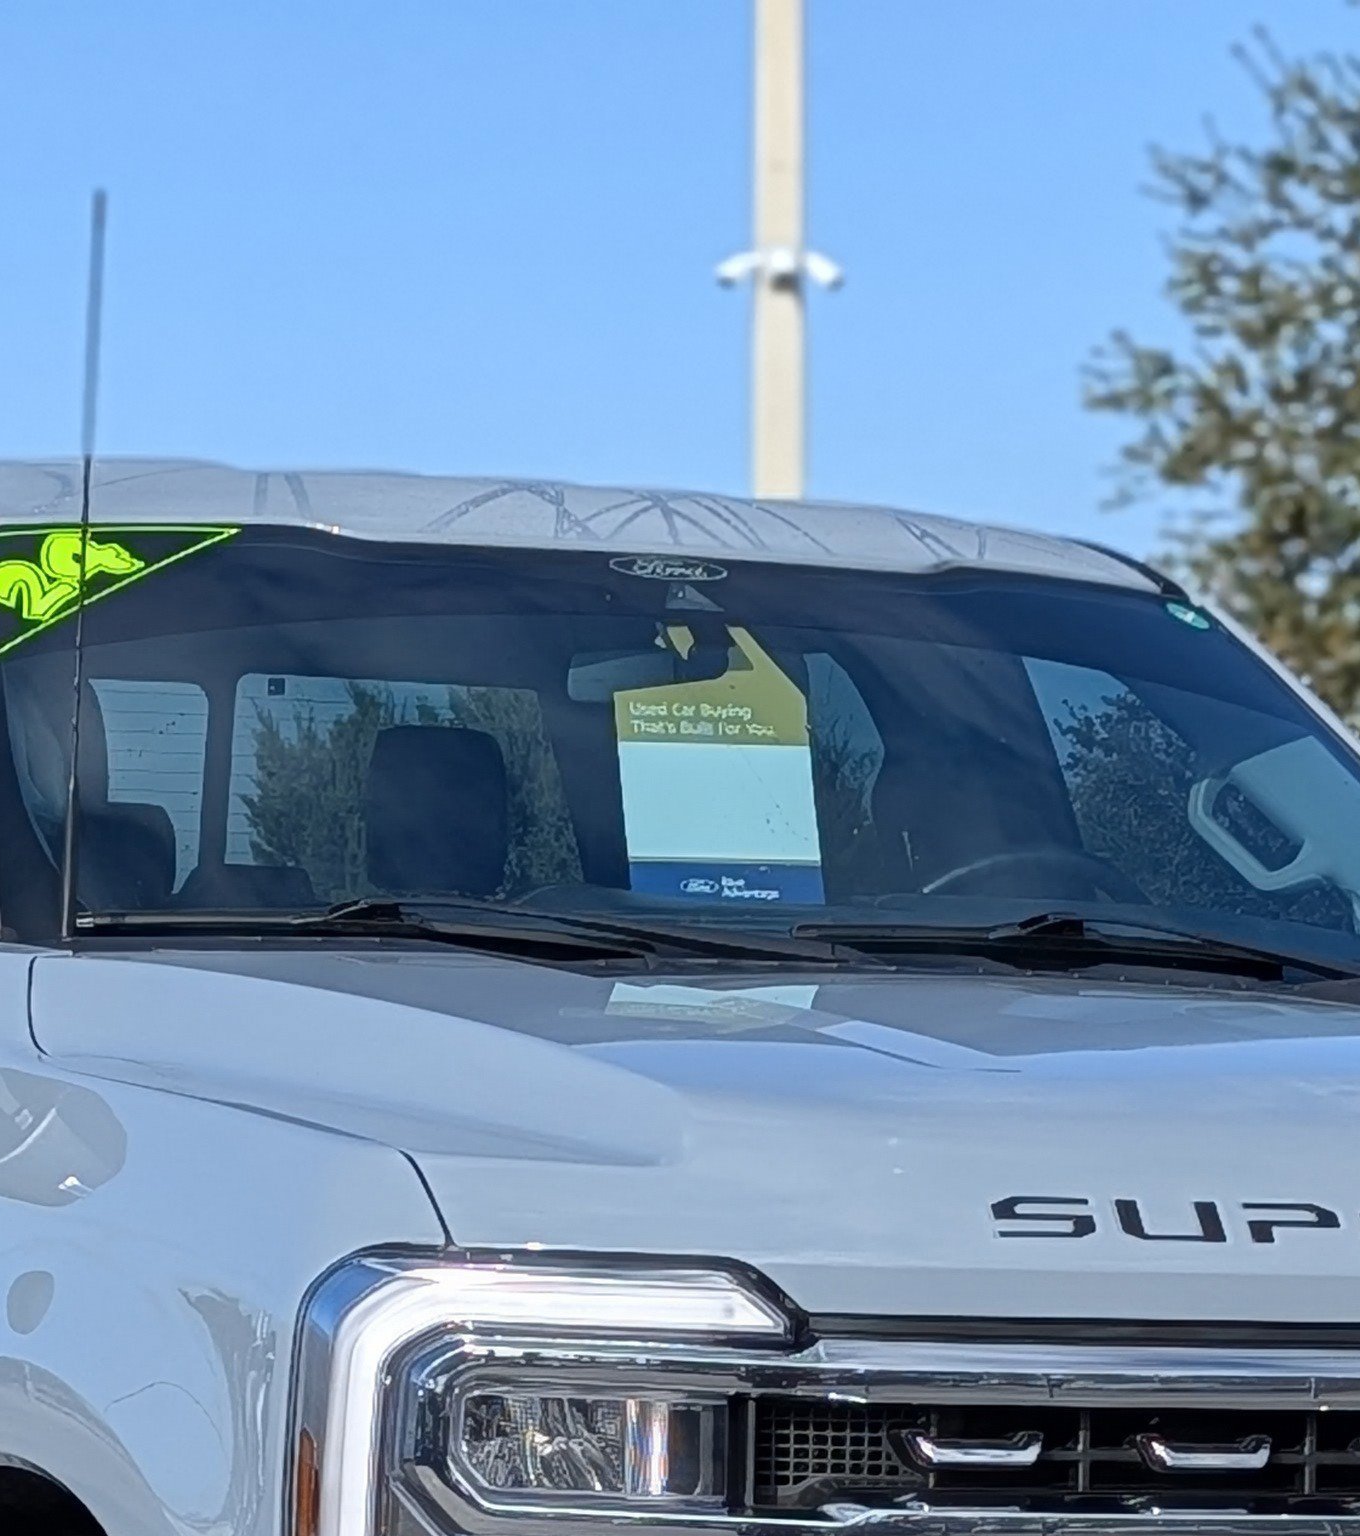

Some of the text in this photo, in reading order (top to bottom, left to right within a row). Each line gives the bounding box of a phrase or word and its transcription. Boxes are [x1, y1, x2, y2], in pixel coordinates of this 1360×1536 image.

[629, 701, 752, 721] Used Car Buying
